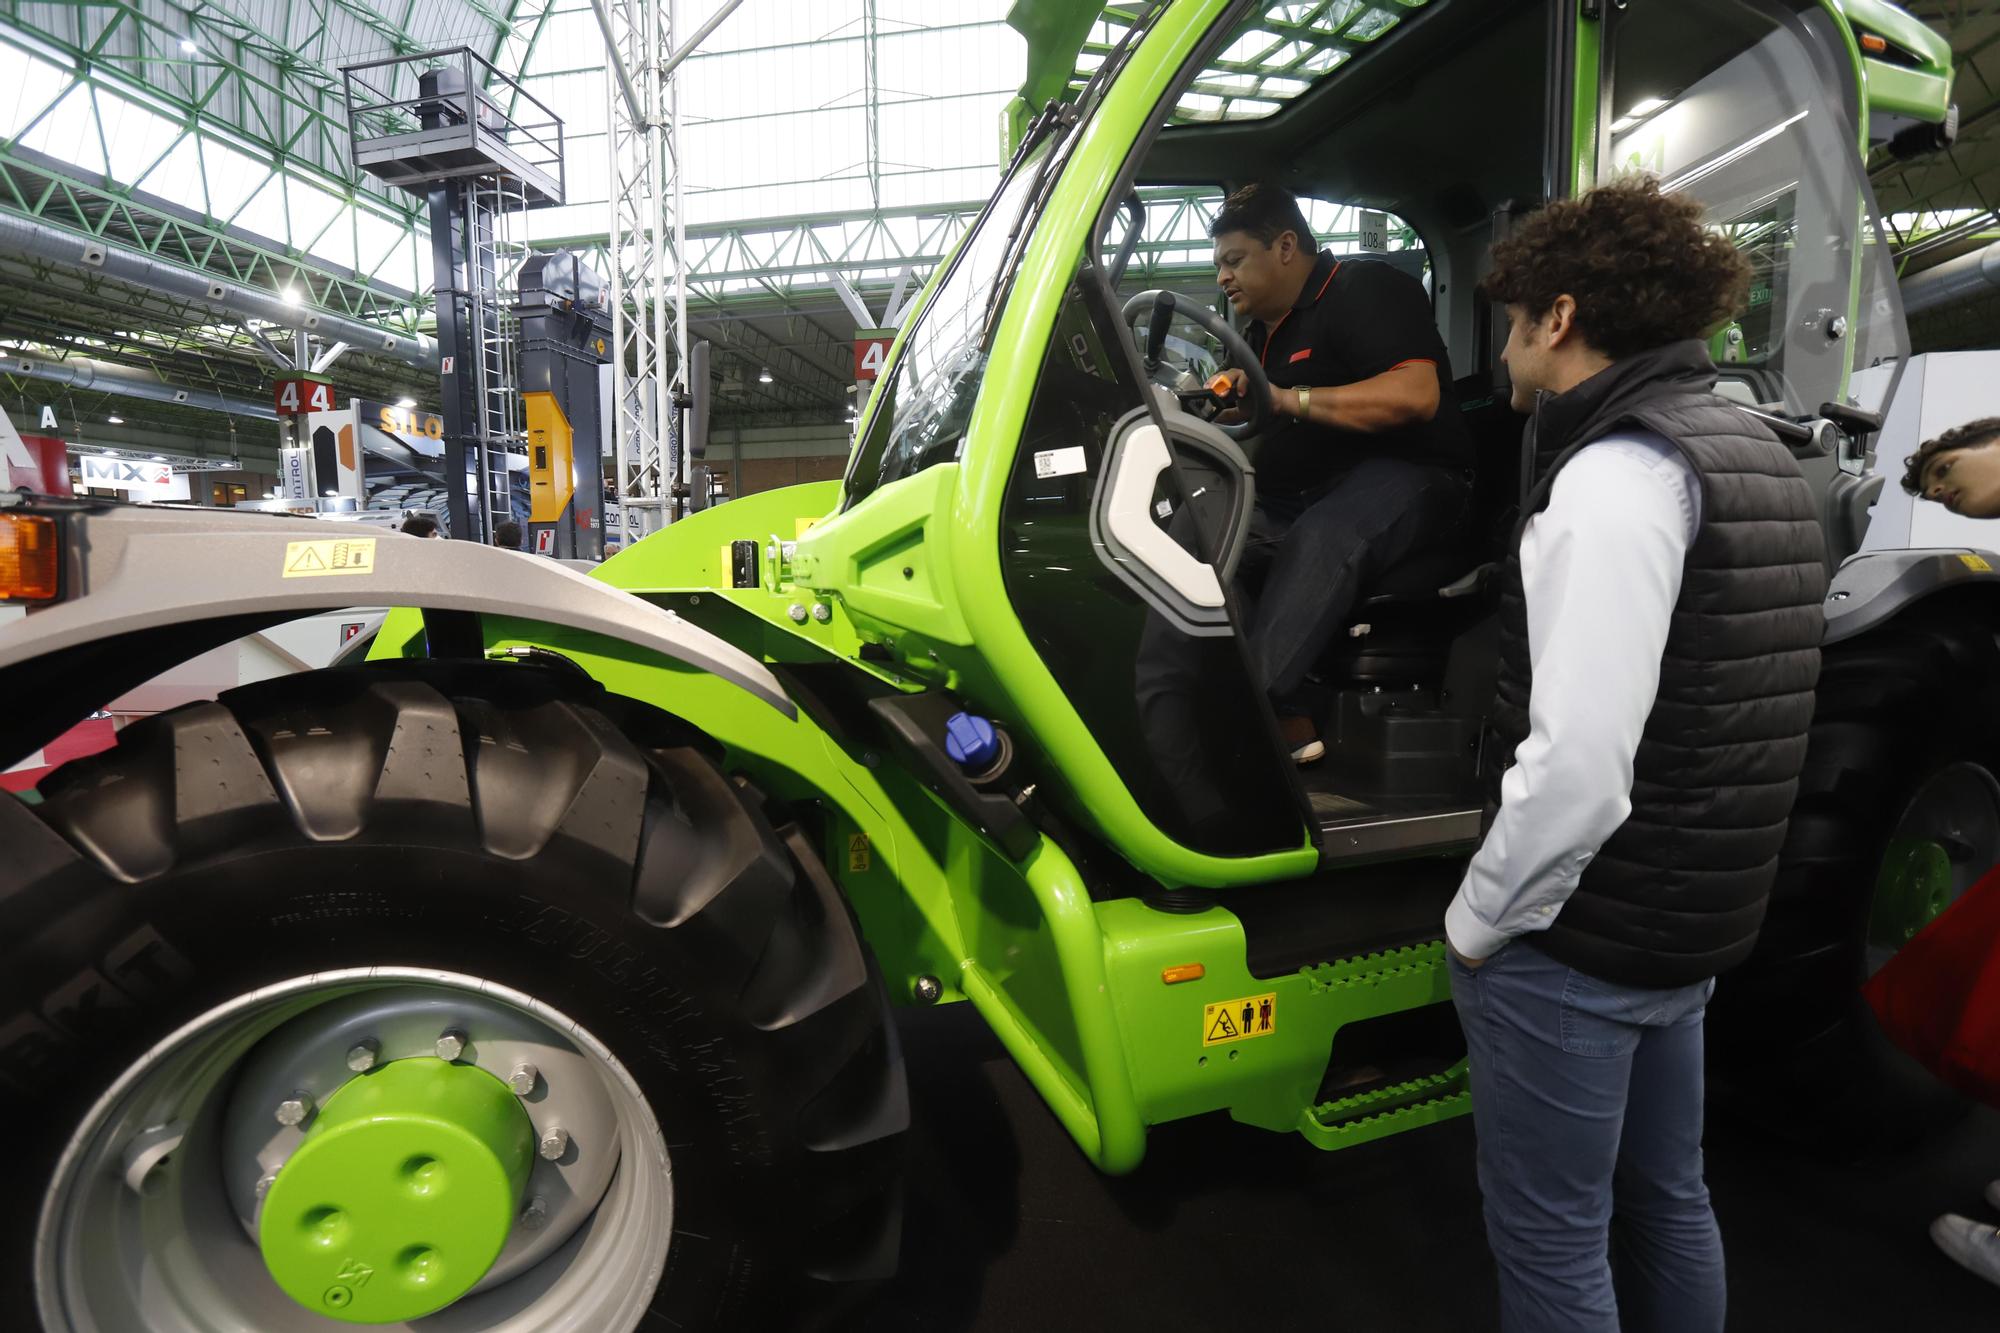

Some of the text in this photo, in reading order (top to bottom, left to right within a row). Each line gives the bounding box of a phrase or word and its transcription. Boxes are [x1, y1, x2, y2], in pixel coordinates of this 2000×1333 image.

[1363, 231, 1378, 248] 108
[862, 342, 884, 375] 4
[281, 382, 299, 411] 4
[311, 385, 329, 412] 4
[41, 406, 58, 428] A
[86, 460, 147, 482] MX
